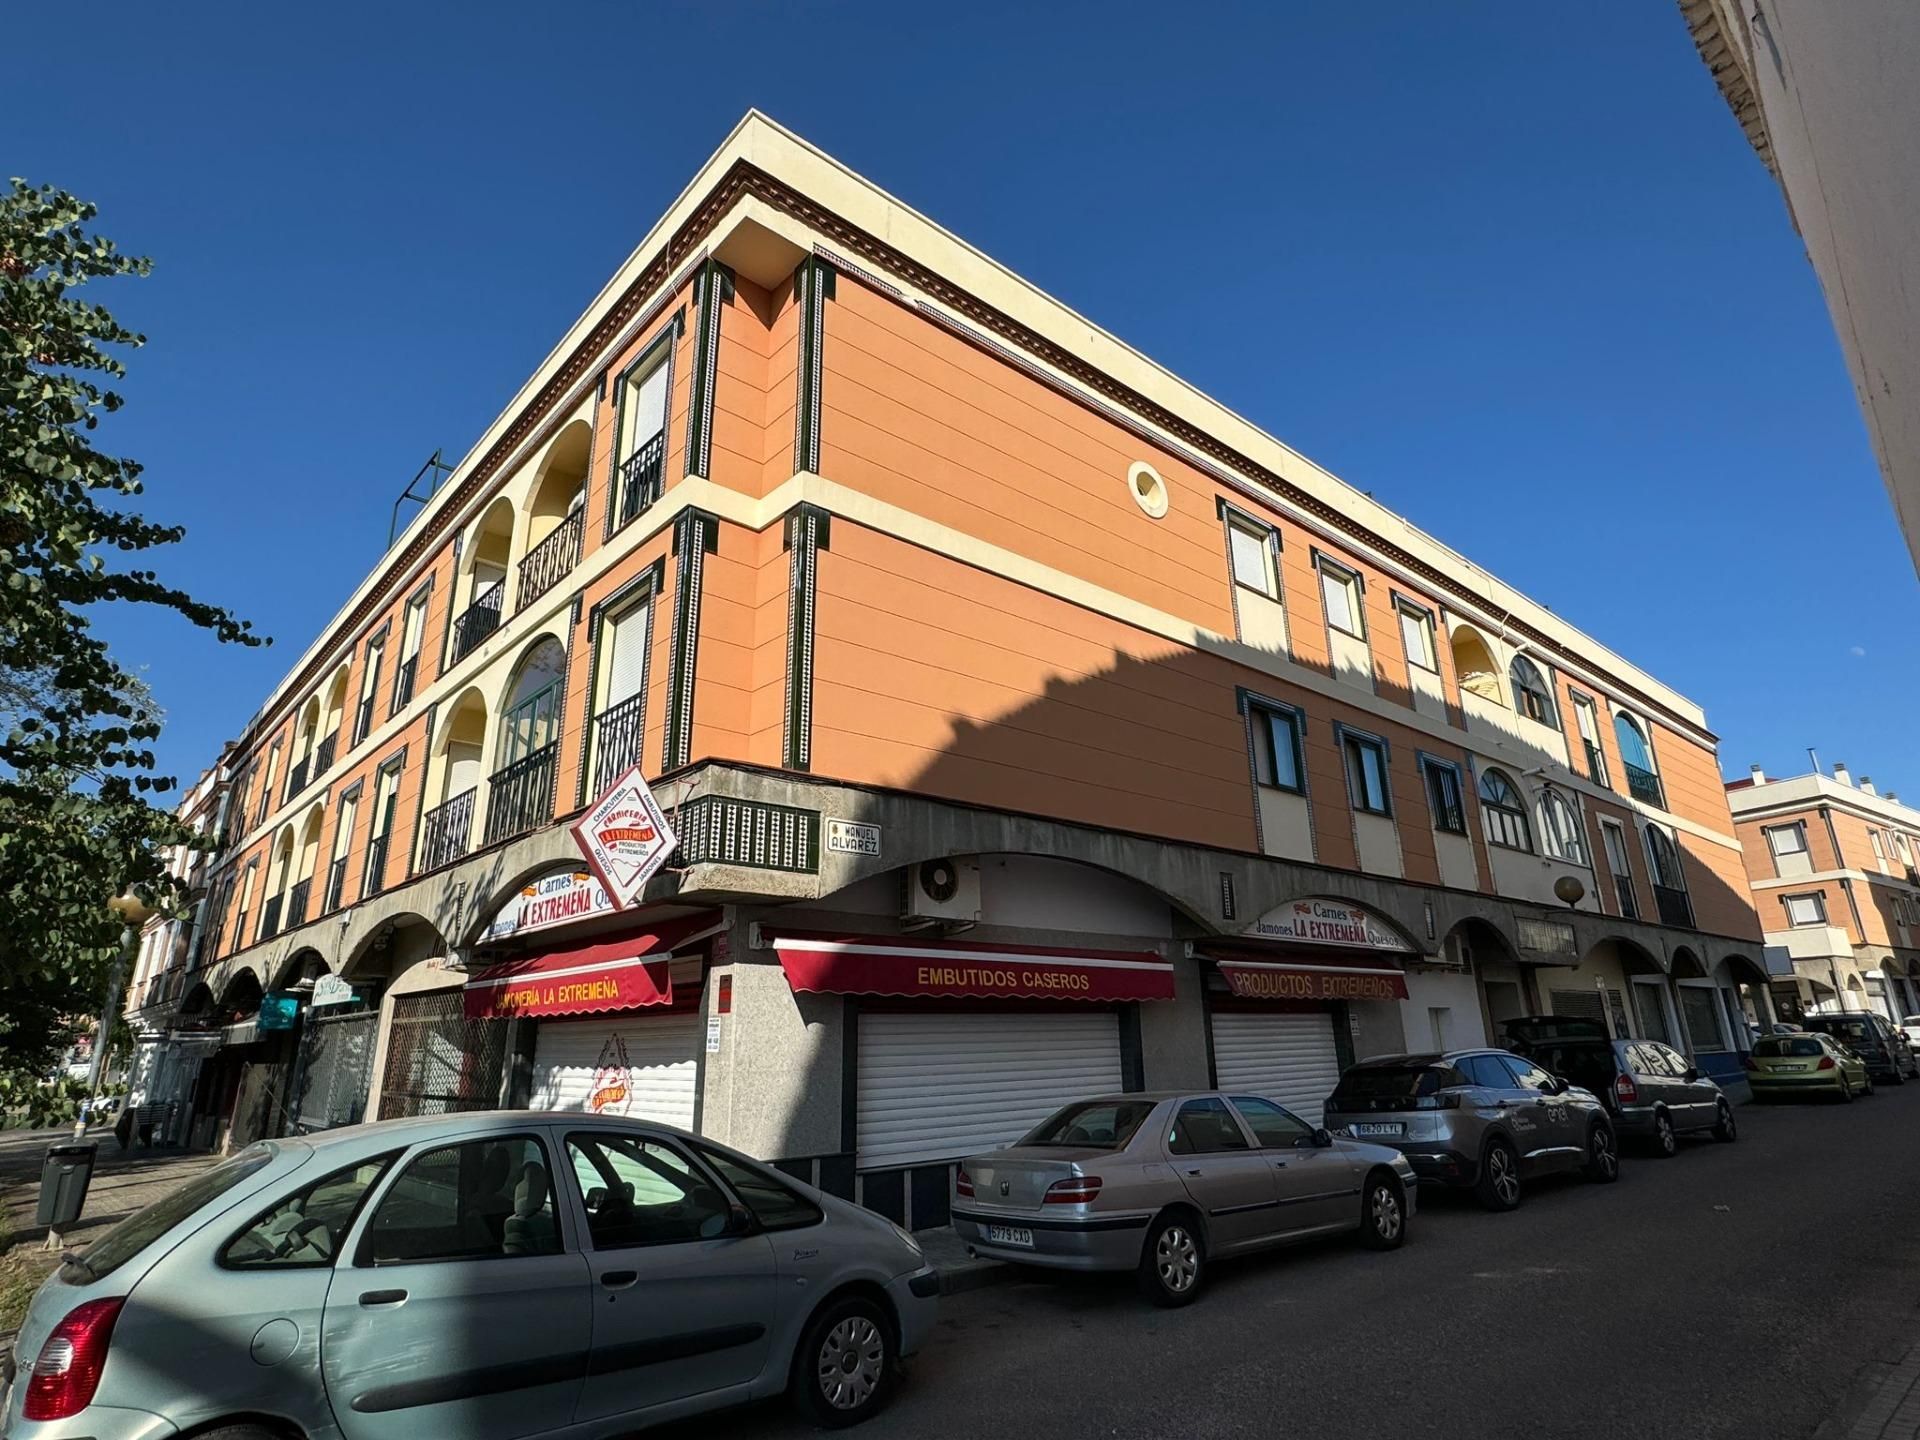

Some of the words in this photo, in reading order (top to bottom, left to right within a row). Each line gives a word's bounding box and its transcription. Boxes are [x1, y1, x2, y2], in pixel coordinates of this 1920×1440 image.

[593, 787, 627, 822] CHARCUTERIA
[643, 794, 666, 830] EMBUTIDOS
[832, 837, 877, 852] ALVAREZ
[845, 826, 875, 840] MANUEL
[594, 848, 612, 876] QUESOS
[639, 855, 661, 881] JAMONES
[538, 875, 572, 895] Carnes
[517, 904, 529, 928] LA
[531, 884, 591, 925] EXTREMEÑA
[1313, 903, 1347, 920] Carnes
[1256, 918, 1293, 936] Jamones
[1293, 919, 1307, 938] LA
[1309, 919, 1367, 943] EXTREMEÑA
[1367, 931, 1399, 946] Quesos
[543, 988, 555, 1005] LA
[559, 975, 619, 1003] EXTREMEÑA
[917, 967, 1017, 987] EMBUTIDOS
[1022, 971, 1090, 990] CASEROS
[1233, 972, 1313, 994] PRODUCTOS
